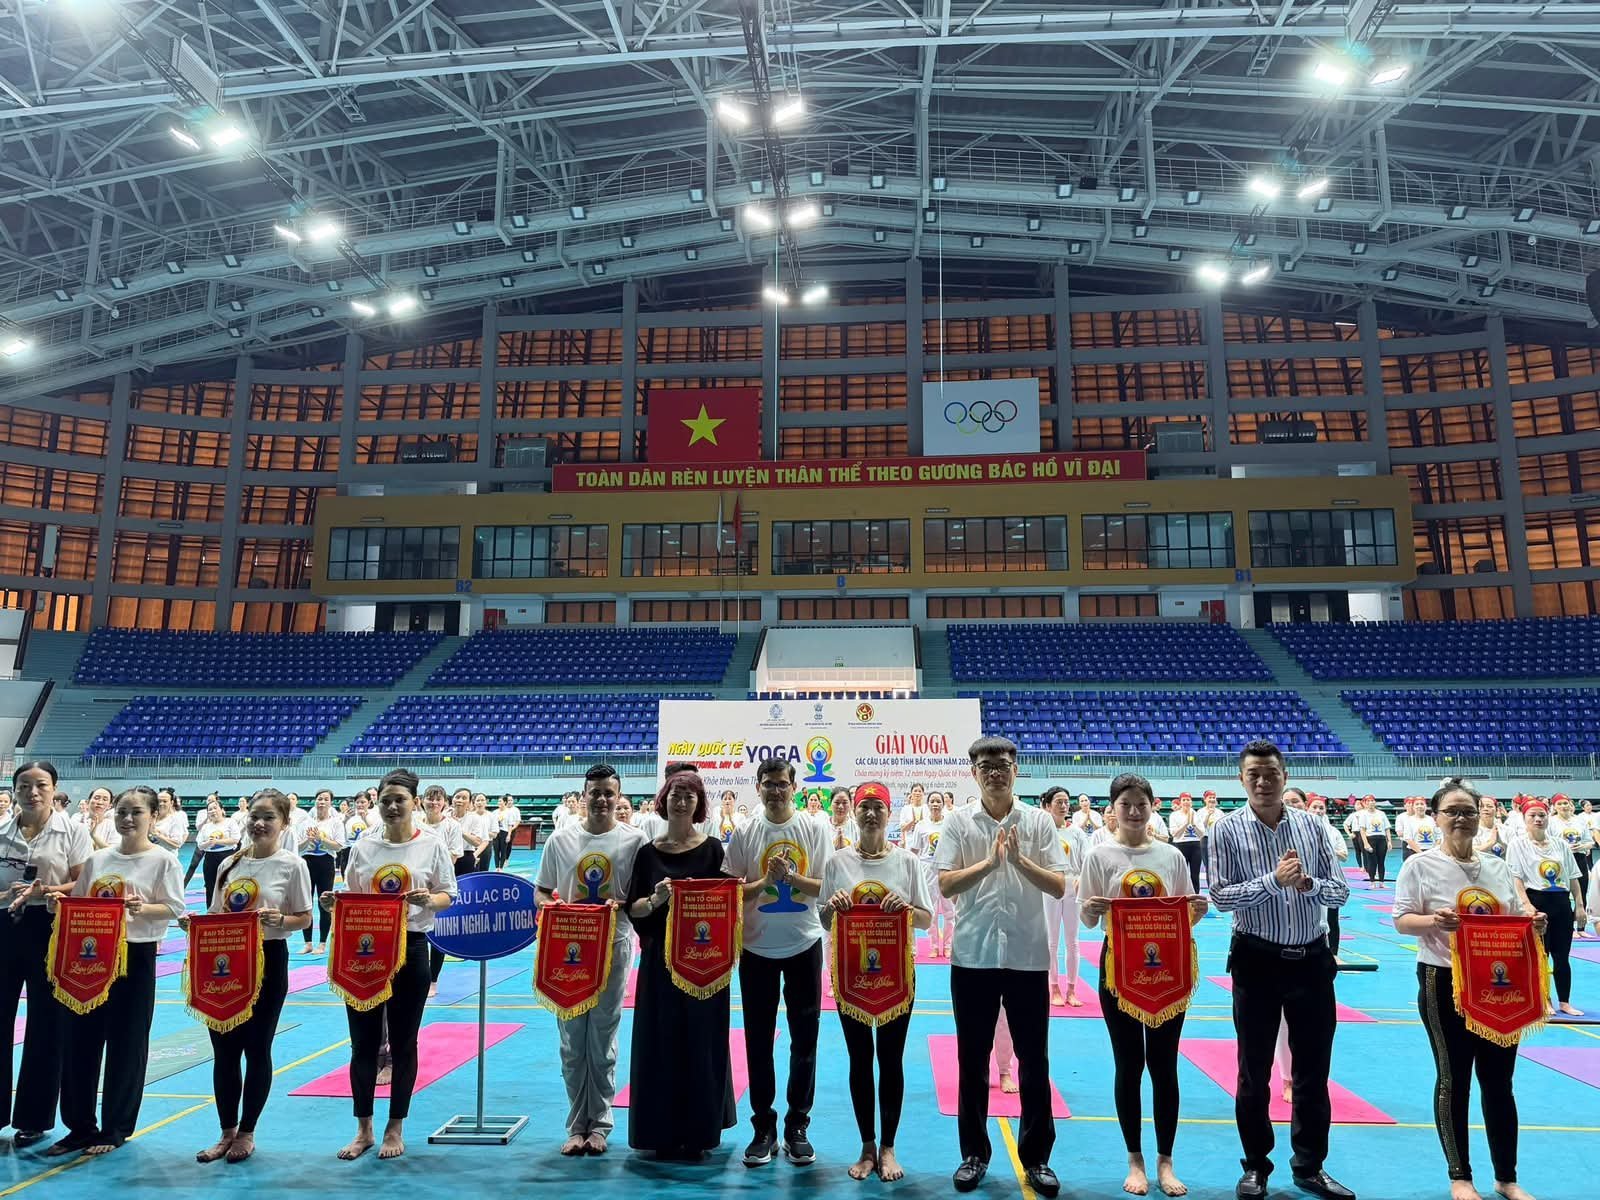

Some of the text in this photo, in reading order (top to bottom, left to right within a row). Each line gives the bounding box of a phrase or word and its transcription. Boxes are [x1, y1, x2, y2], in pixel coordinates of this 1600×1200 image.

[576, 456, 1120, 488] TOÀN DÂN RÈN LUYỆN THÂN THỂ THEO GƯƠNG BÁC HỒ VĨ ĐẠI
[836, 575, 846, 588] B
[1235, 569, 1251, 582] B1
[456, 580, 472, 592] B2
[668, 738, 746, 758] NGÀY QUỐC TẾ
[876, 730, 948, 754] GIẢI YOGA
[746, 745, 801, 763] YOGA
[719, 760, 732, 768] DAY
[734, 760, 744, 768] OF
[855, 757, 866, 766] CÁC
[880, 758, 890, 768] LẠC
[891, 757, 899, 767] BỘ
[916, 756, 926, 766] BẮC
[928, 758, 942, 766] NINH
[944, 757, 958, 766] NĂM
[720, 776, 734, 786] theo
[476, 889, 498, 906] LẠC
[502, 884, 520, 903] BỘ
[434, 909, 534, 937] MINH NGHĨA JIT YOGA
